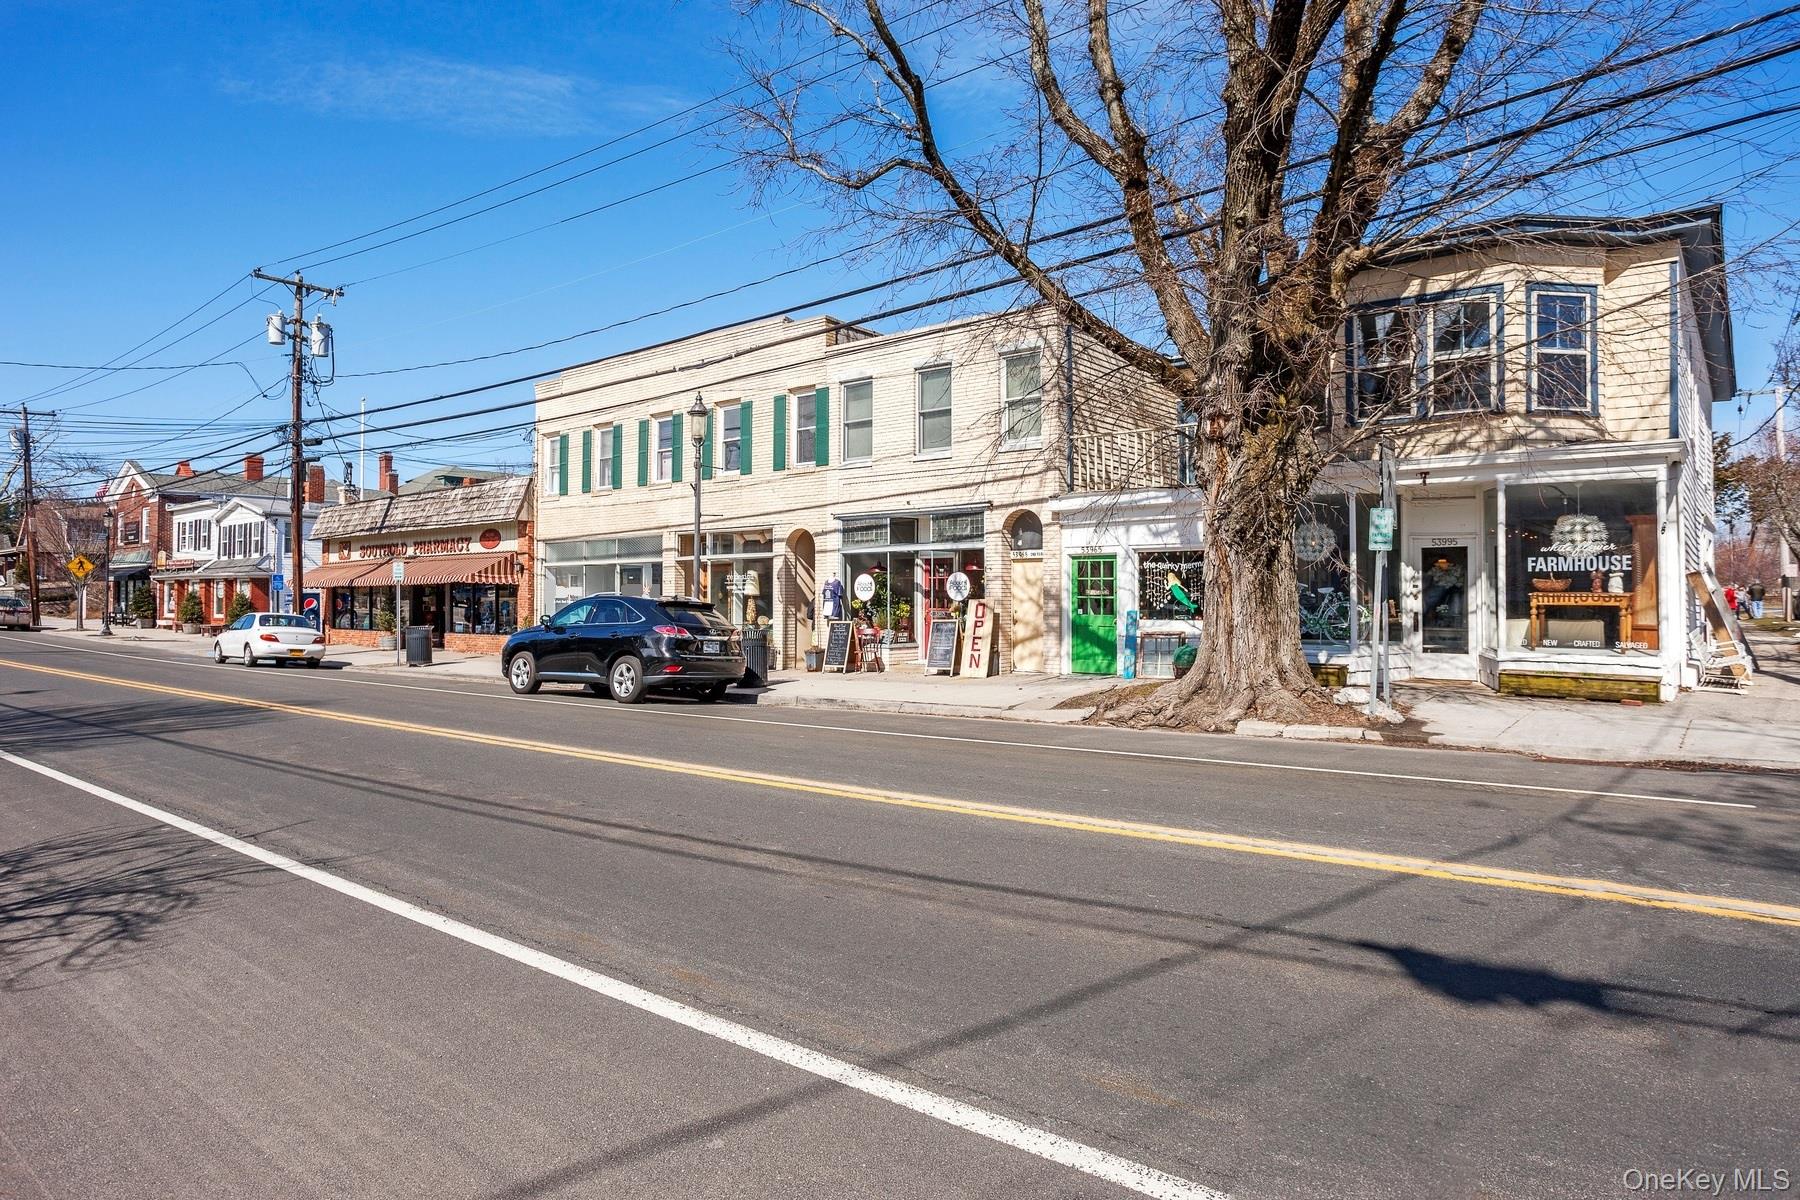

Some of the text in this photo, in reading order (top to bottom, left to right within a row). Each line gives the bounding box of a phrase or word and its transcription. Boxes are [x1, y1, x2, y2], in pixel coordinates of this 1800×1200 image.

[1431, 537, 1458, 546] 53995
[1540, 541, 1573, 552] white
[359, 537, 473, 559] SOUTHOLD PHARMACY
[1081, 546, 1103, 554] 53965
[1180, 561, 1204, 571] merm
[1527, 555, 1633, 573] FARMHOUSE
[968, 602, 986, 669] OPEN
[1542, 639, 1558, 647] NEW
[1573, 640, 1601, 648] CRAFTED
[1614, 641, 1649, 649] SALVAGED
